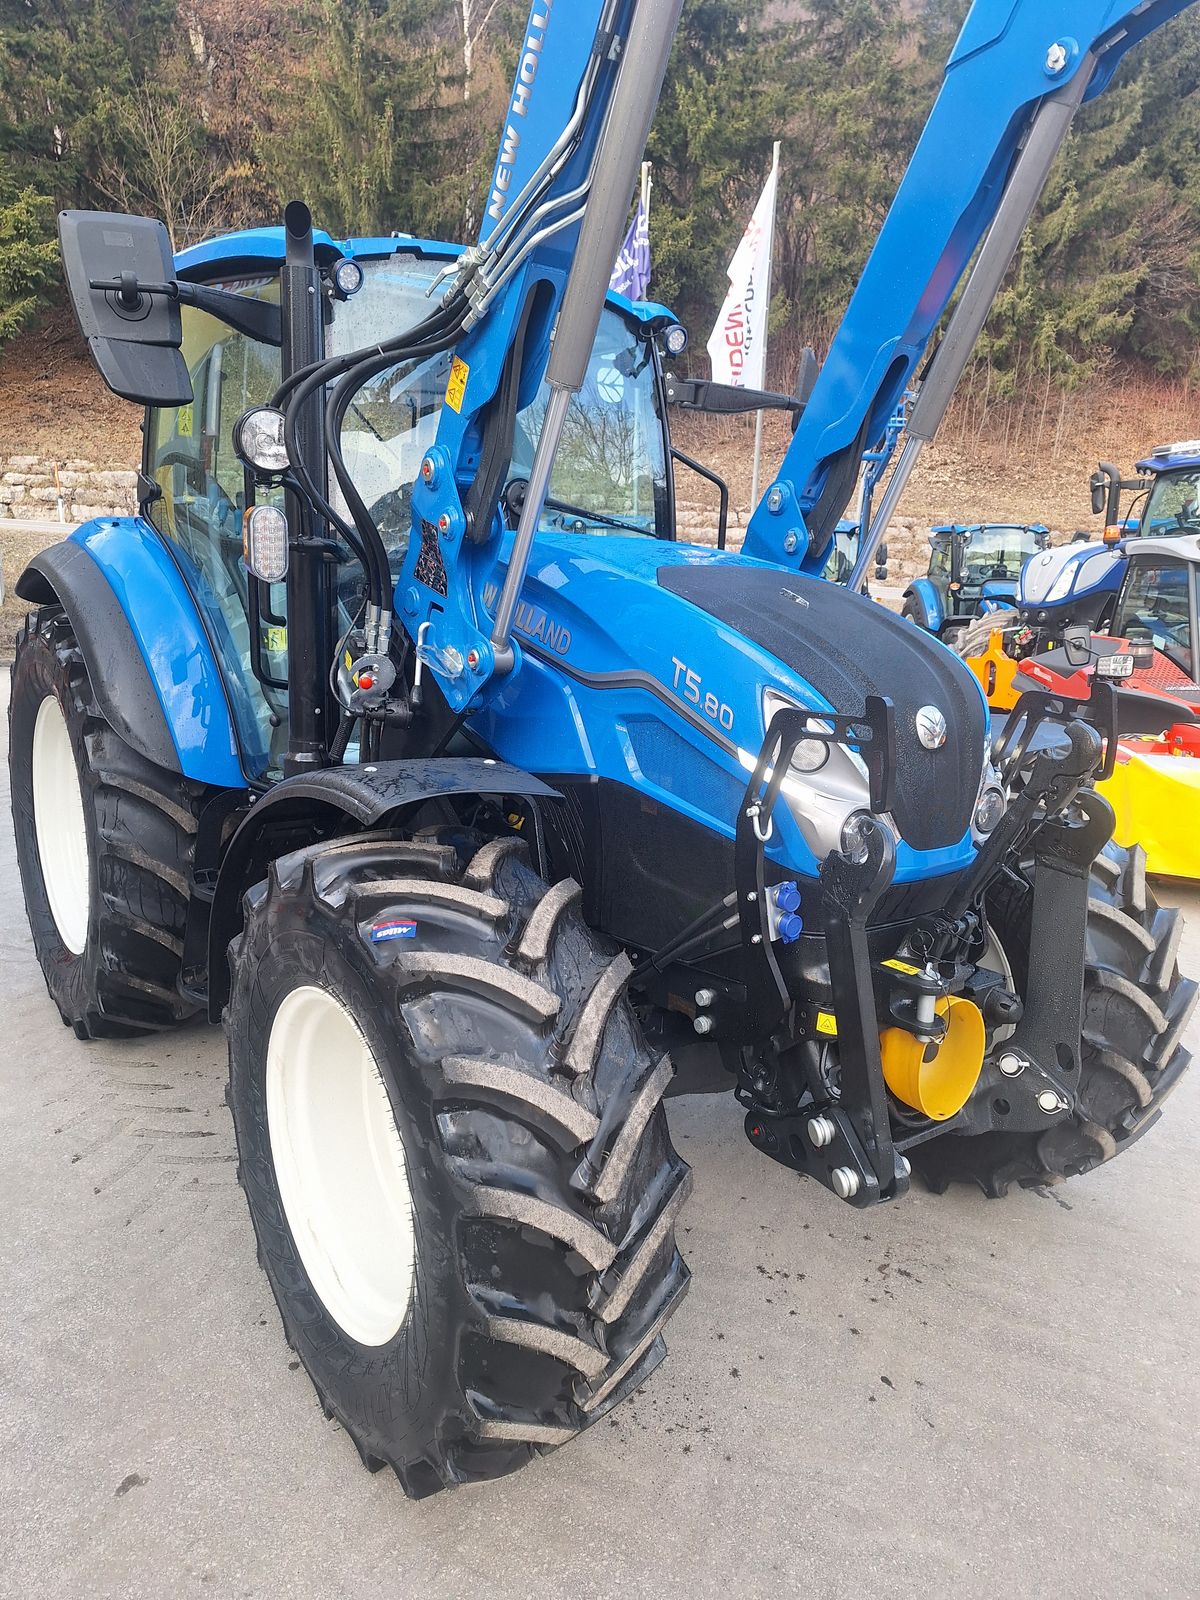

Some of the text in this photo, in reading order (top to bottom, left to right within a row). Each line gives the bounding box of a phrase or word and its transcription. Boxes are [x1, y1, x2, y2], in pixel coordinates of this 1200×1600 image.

[488, 124, 521, 221] NEW
[496, 591, 572, 655] LLAND
[671, 656, 734, 730] T5.80
